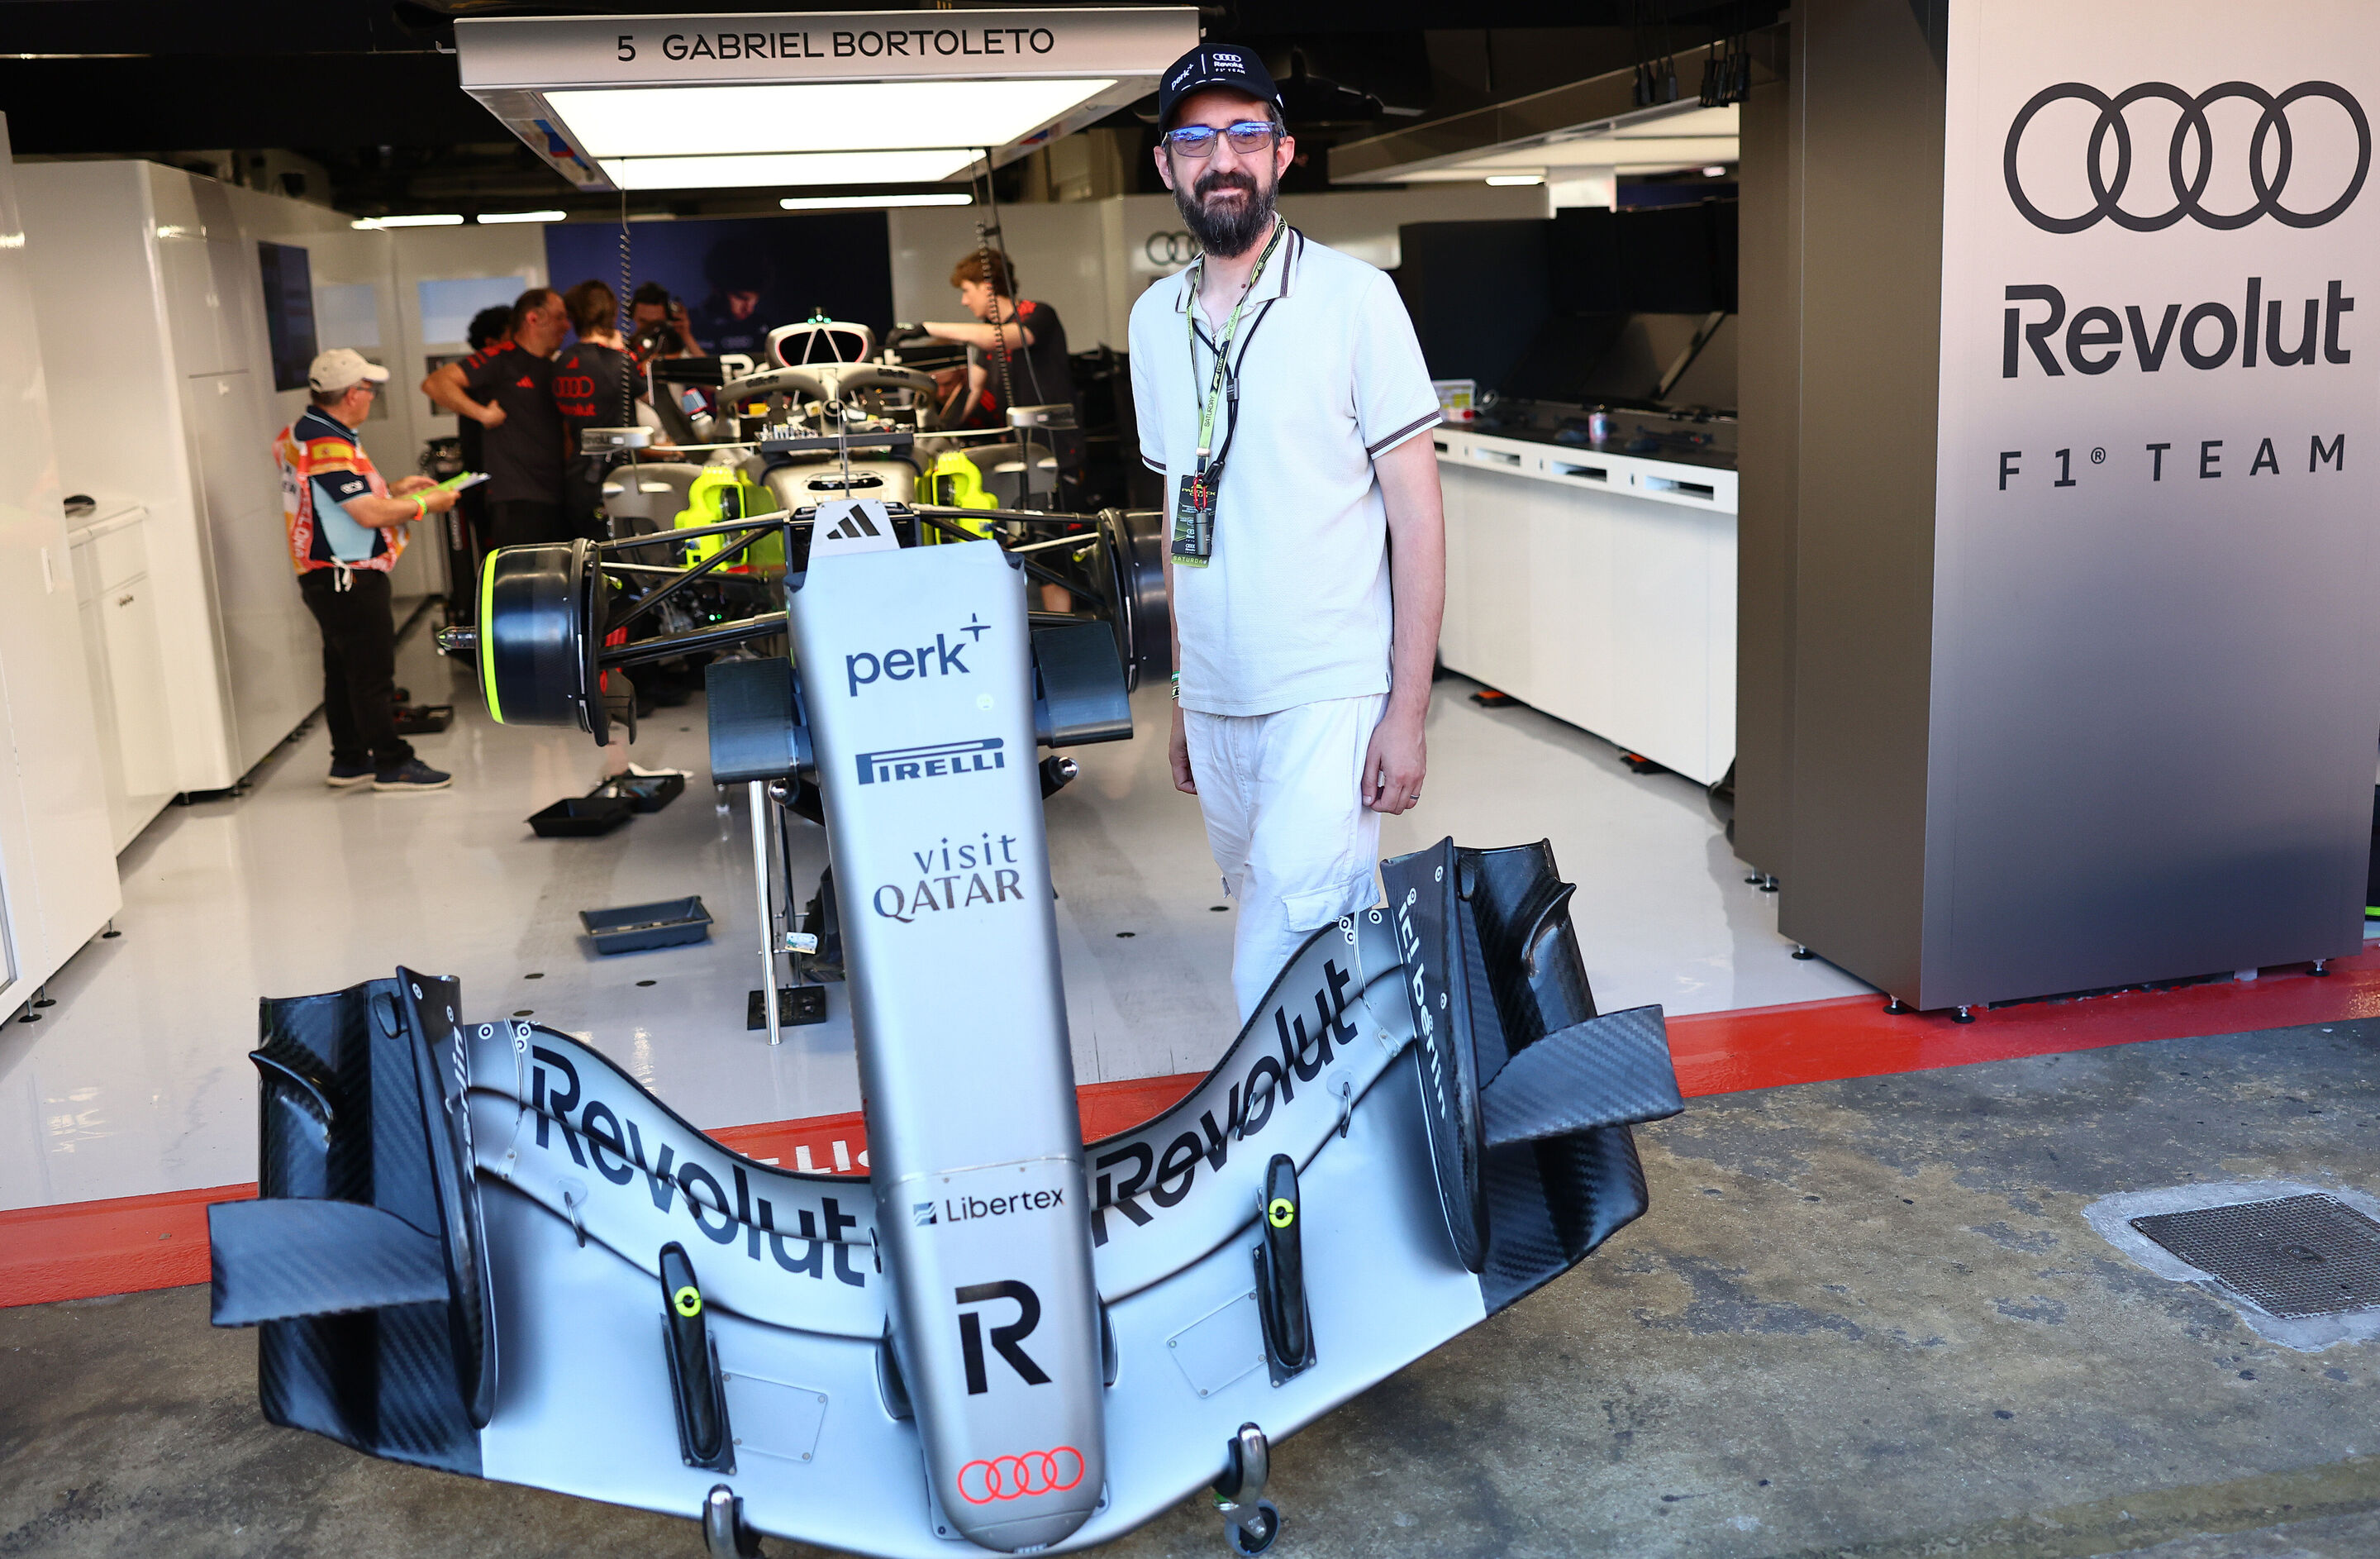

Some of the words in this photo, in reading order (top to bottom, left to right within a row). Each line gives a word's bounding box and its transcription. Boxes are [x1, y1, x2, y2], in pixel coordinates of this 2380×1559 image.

[617, 36, 636, 62] 5
[662, 32, 825, 60] GABRIEL
[832, 28, 1054, 57] BORTOLETO
[2002, 277, 2354, 379] Revolut
[1204, 395, 1215, 427] SATURDAY
[2146, 434, 2345, 481] TEAM
[854, 737, 1005, 785] PIRELLI
[912, 832, 1018, 875] visit
[873, 869, 1025, 924] QATAR
[1412, 962, 1446, 1120] berlin
[1090, 957, 1359, 1249] Revolut
[531, 1045, 865, 1288] Revolut
[945, 1187, 1065, 1223] Libertex
